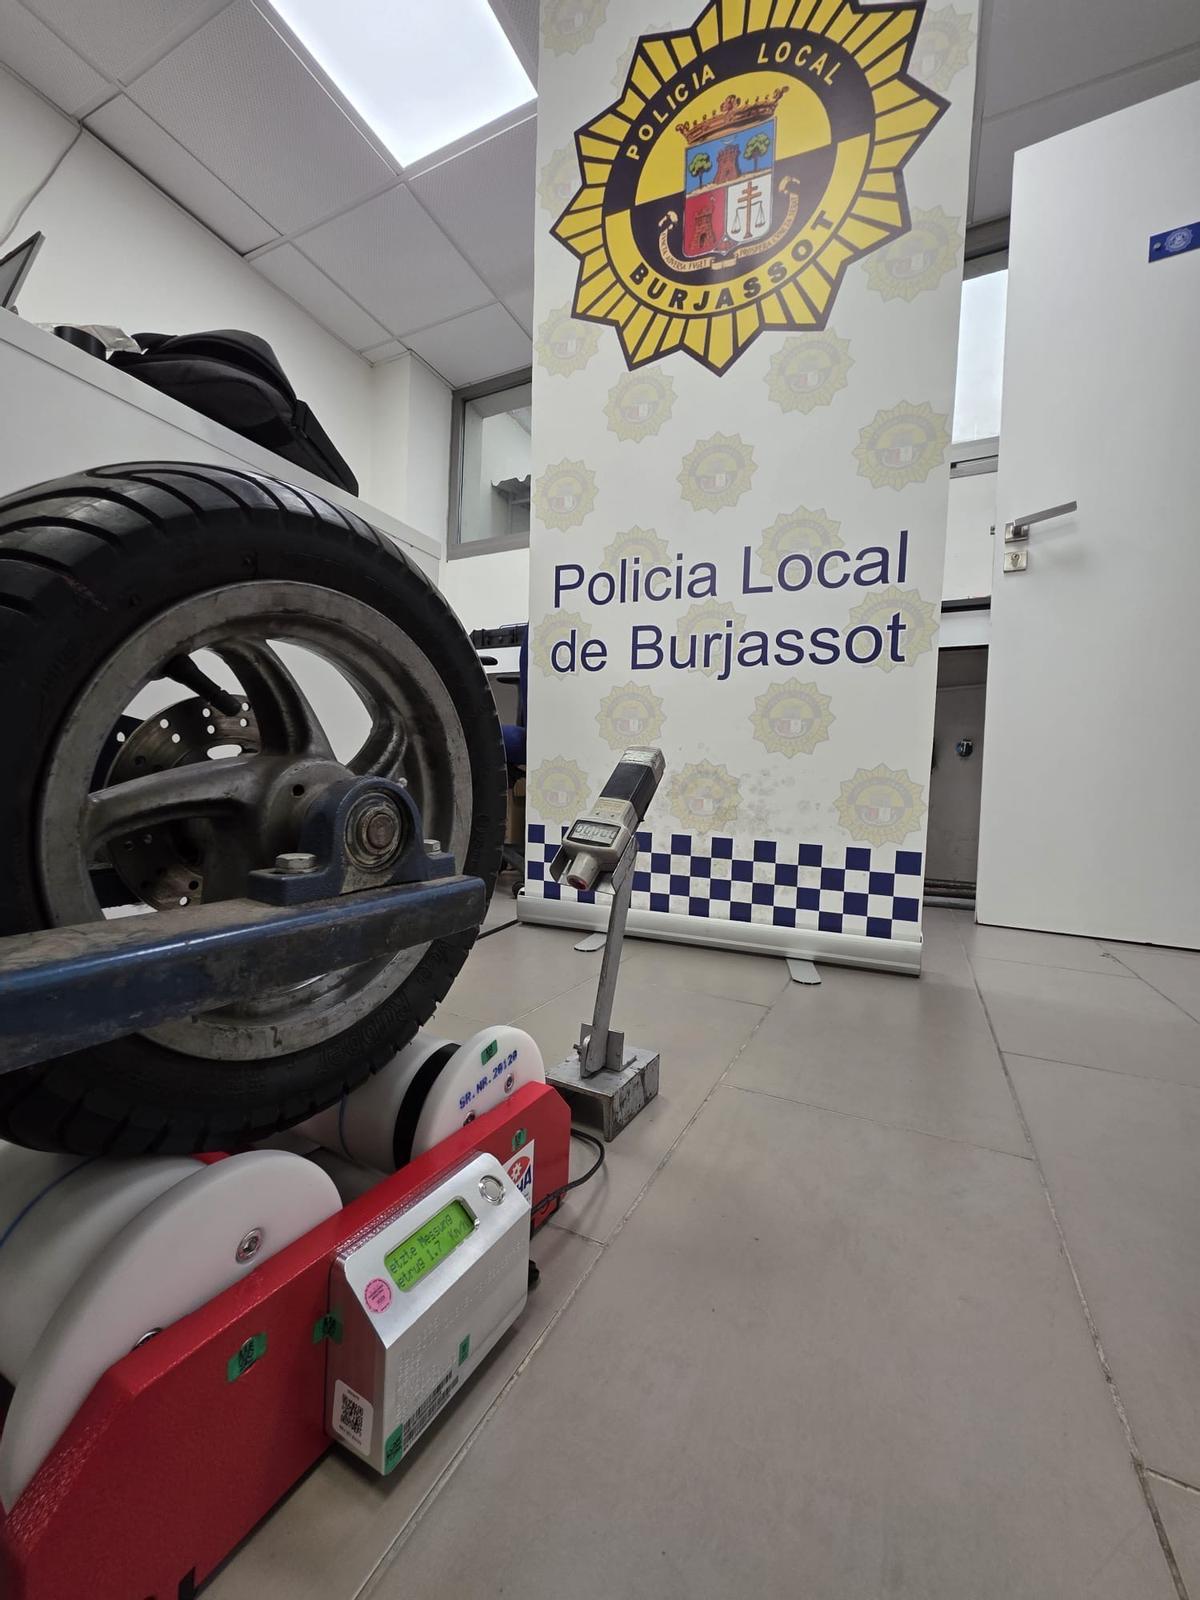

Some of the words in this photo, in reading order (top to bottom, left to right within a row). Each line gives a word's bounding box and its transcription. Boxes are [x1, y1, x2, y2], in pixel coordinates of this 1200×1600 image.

[626, 65, 715, 160] POLICIA
[757, 41, 843, 86] LOCAL
[630, 210, 835, 312] BURJASSOT
[553, 552, 718, 609] Policia
[741, 530, 909, 594] Local
[551, 629, 607, 673] de
[630, 611, 906, 681] Burjassot
